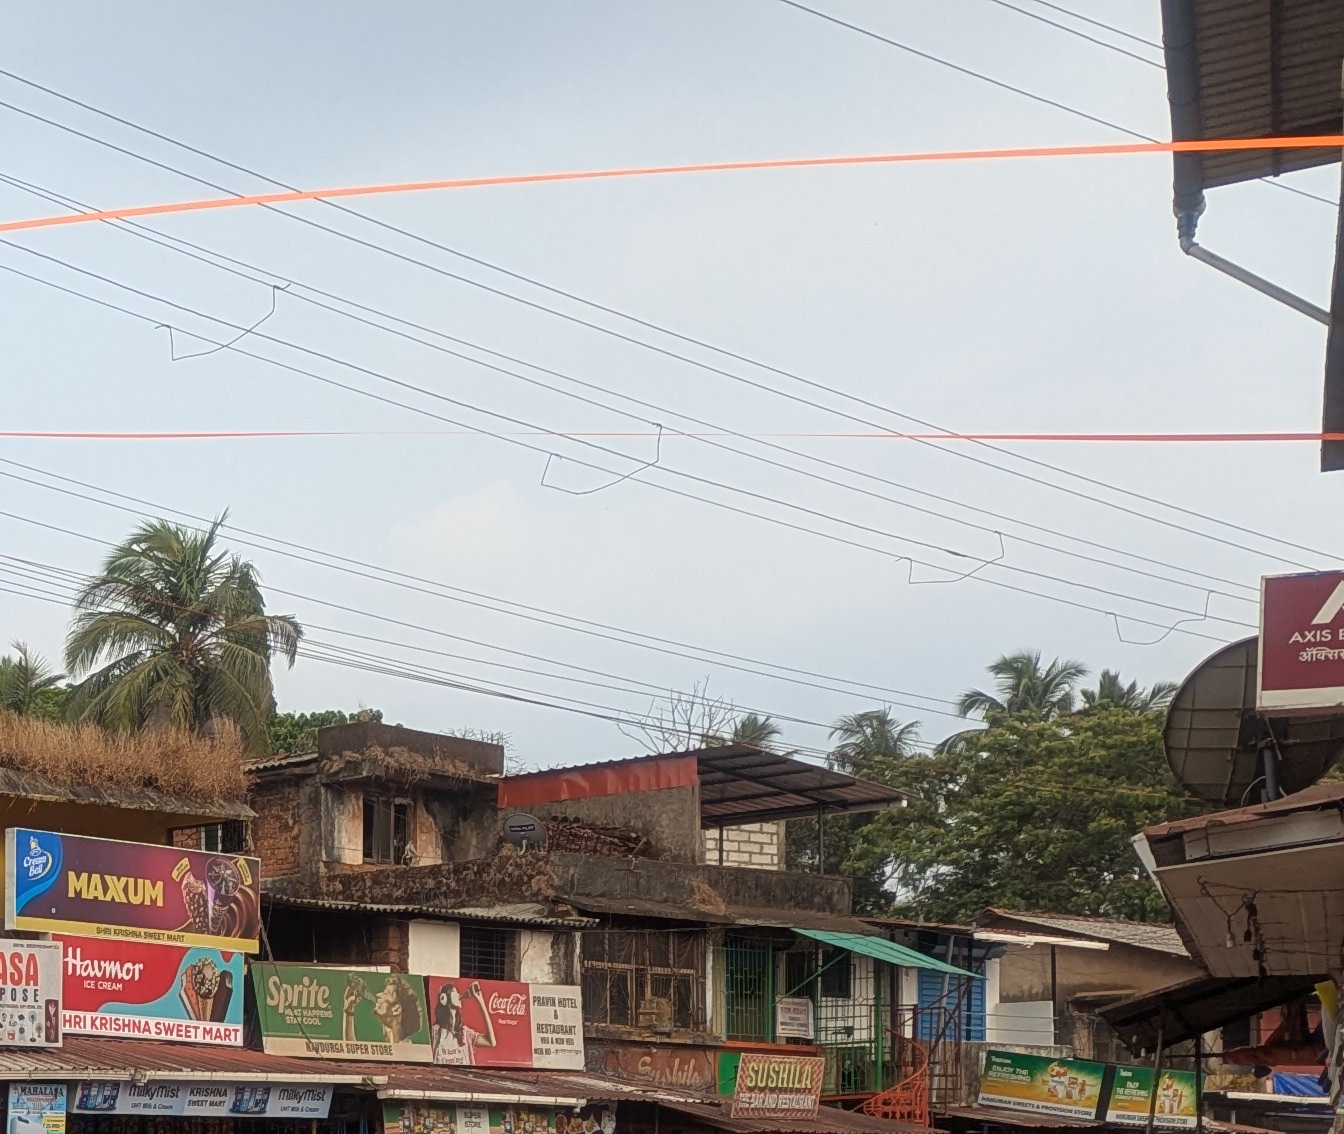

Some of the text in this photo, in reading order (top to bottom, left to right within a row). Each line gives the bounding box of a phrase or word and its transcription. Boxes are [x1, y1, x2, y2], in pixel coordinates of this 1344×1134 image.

[1289, 629, 1332, 645] AXIS
[143, 930, 166, 941] SWEET
[167, 933, 185, 943] MART
[63, 946, 143, 982] Havmor
[84, 980, 123, 991] ICE CREAM
[267, 975, 330, 1014] Sprite
[558, 997, 578, 1009] HOTEL
[63, 1013, 240, 1042] HRI KRISHNA SWEET MART
[303, 1017, 321, 1026] COOL
[346, 1043, 369, 1055] SUPER
[371, 1044, 393, 1056] STORE
[747, 1062, 812, 1090] SUSHILA
[189, 1087, 228, 1098] KRISHNA
